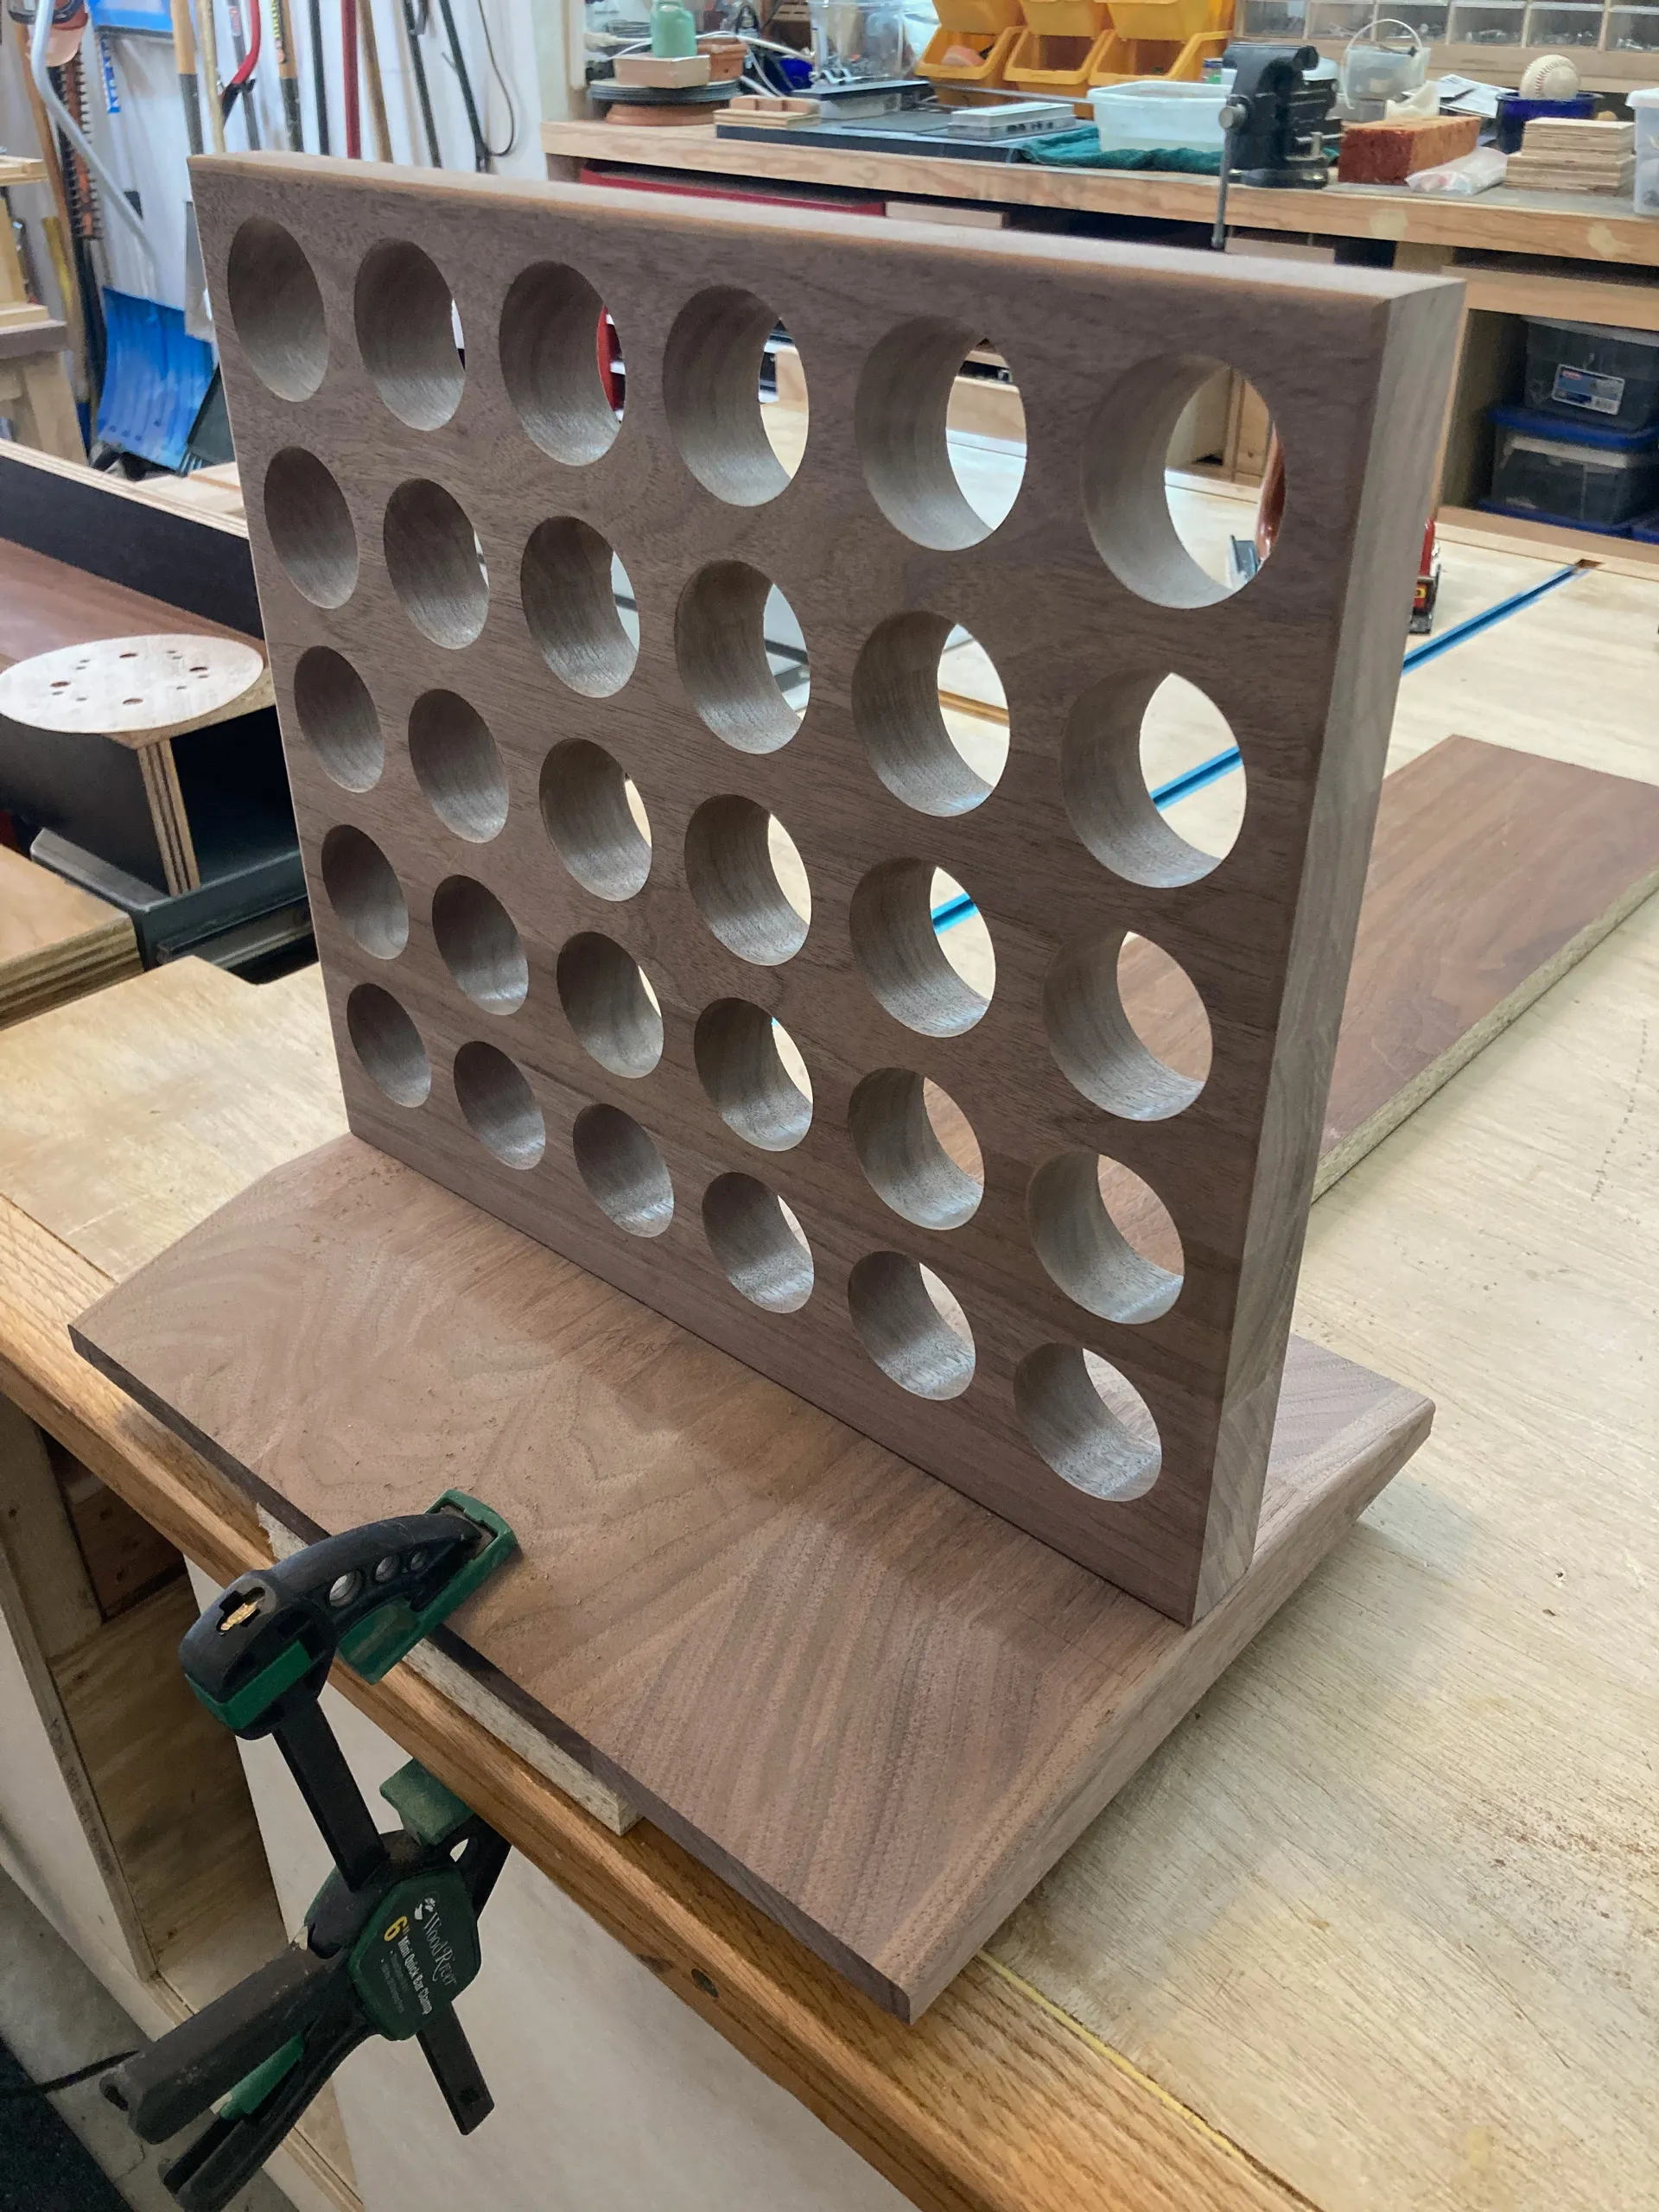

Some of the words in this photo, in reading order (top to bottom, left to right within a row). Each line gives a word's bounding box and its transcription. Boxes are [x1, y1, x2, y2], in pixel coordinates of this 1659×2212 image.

[398, 1936, 413, 1958] Mini
[404, 1953, 420, 1980] Quick
[413, 1974, 424, 1992] Bar
[417, 1987, 432, 2015] Clamp
